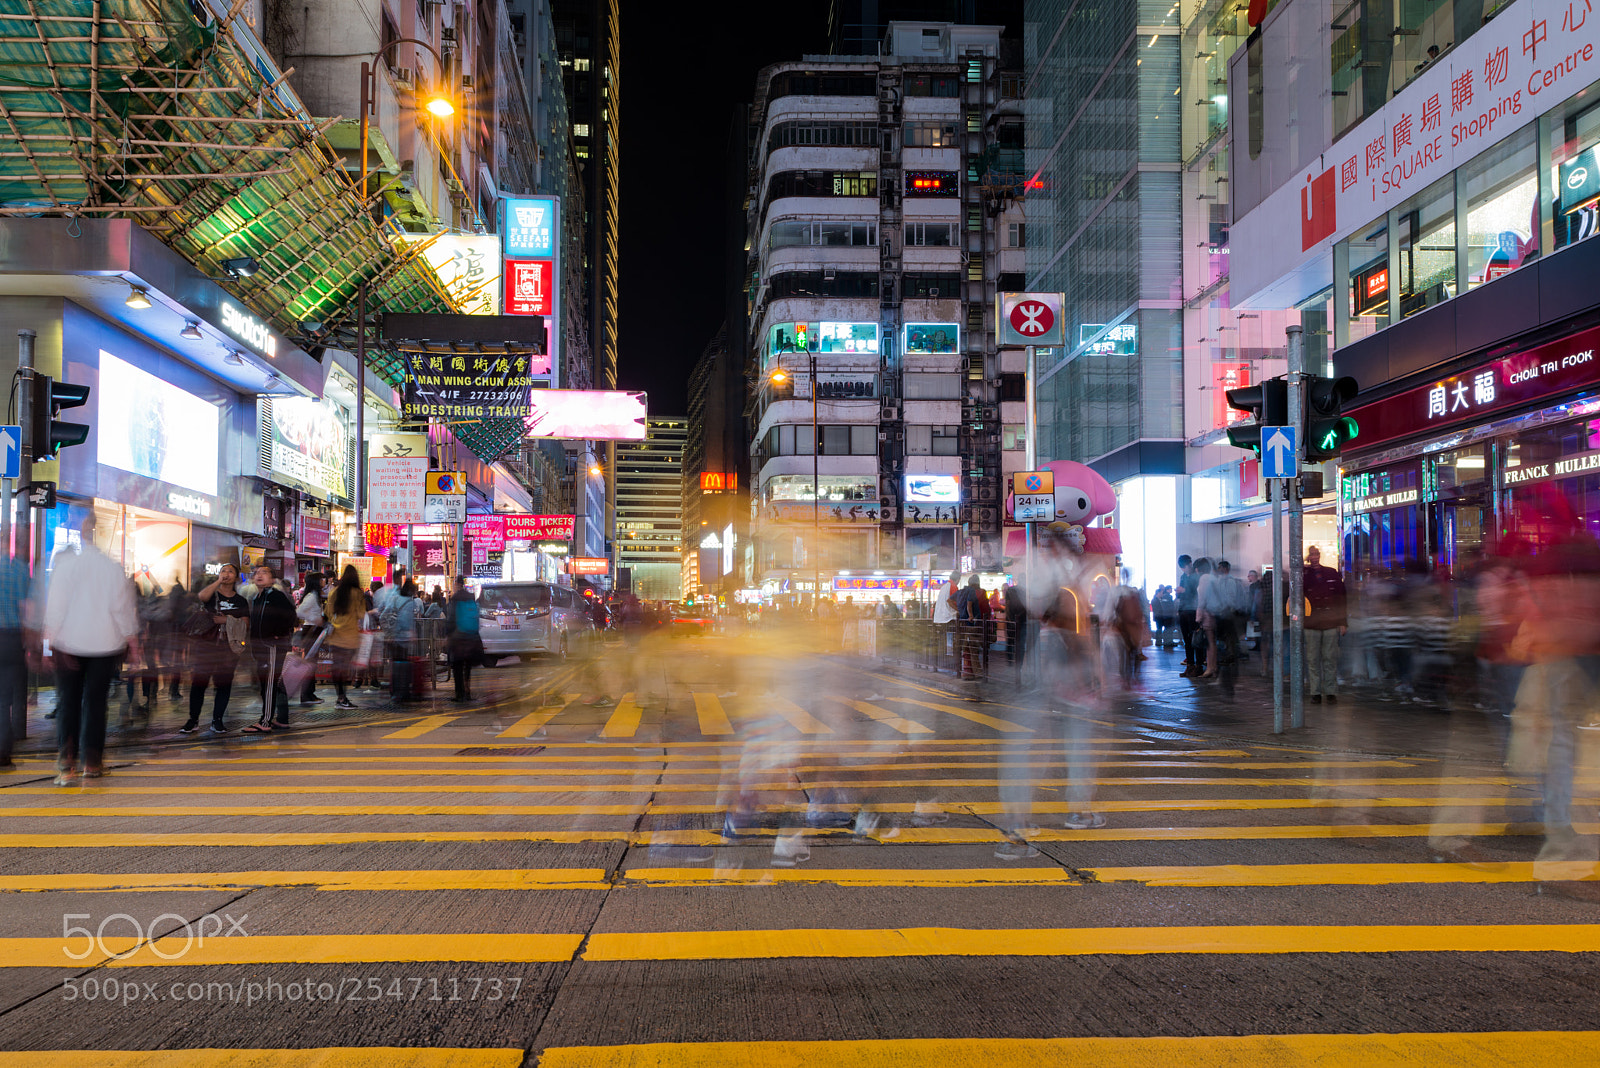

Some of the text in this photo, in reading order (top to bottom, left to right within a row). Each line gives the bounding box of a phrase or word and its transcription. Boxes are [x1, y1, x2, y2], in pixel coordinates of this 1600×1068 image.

[1341, 0, 1593, 193] 國際廣場購物中心
[1382, 136, 1443, 194] SQUARE
[1451, 89, 1522, 147] Shopping
[1527, 43, 1594, 96] Centre
[510, 235, 549, 243] SEEFAH
[222, 302, 270, 354] swatch
[1510, 350, 1594, 385] CHOW TAI FOOK
[405, 374, 414, 384] IP
[417, 375, 440, 386] MAN
[443, 376, 472, 386] WING
[475, 376, 504, 387] CHUN
[440, 390, 523, 400] 4/F 27232306
[1428, 370, 1496, 419] 周大福
[405, 403, 532, 417] SHOESTRING TRAVEL
[1504, 464, 1550, 484] FRANCK
[430, 498, 461, 506] 24 hrs
[1018, 497, 1050, 506] 24 hrs
[1354, 496, 1384, 511] FRANCK
[433, 509, 457, 520] 全日
[466, 515, 504, 523] hoestring
[1022, 507, 1046, 519] 全日
[505, 517, 574, 527] TOURS TICKETS
[506, 528, 572, 538] CHINA VISA
[475, 564, 503, 572] TAILORS
